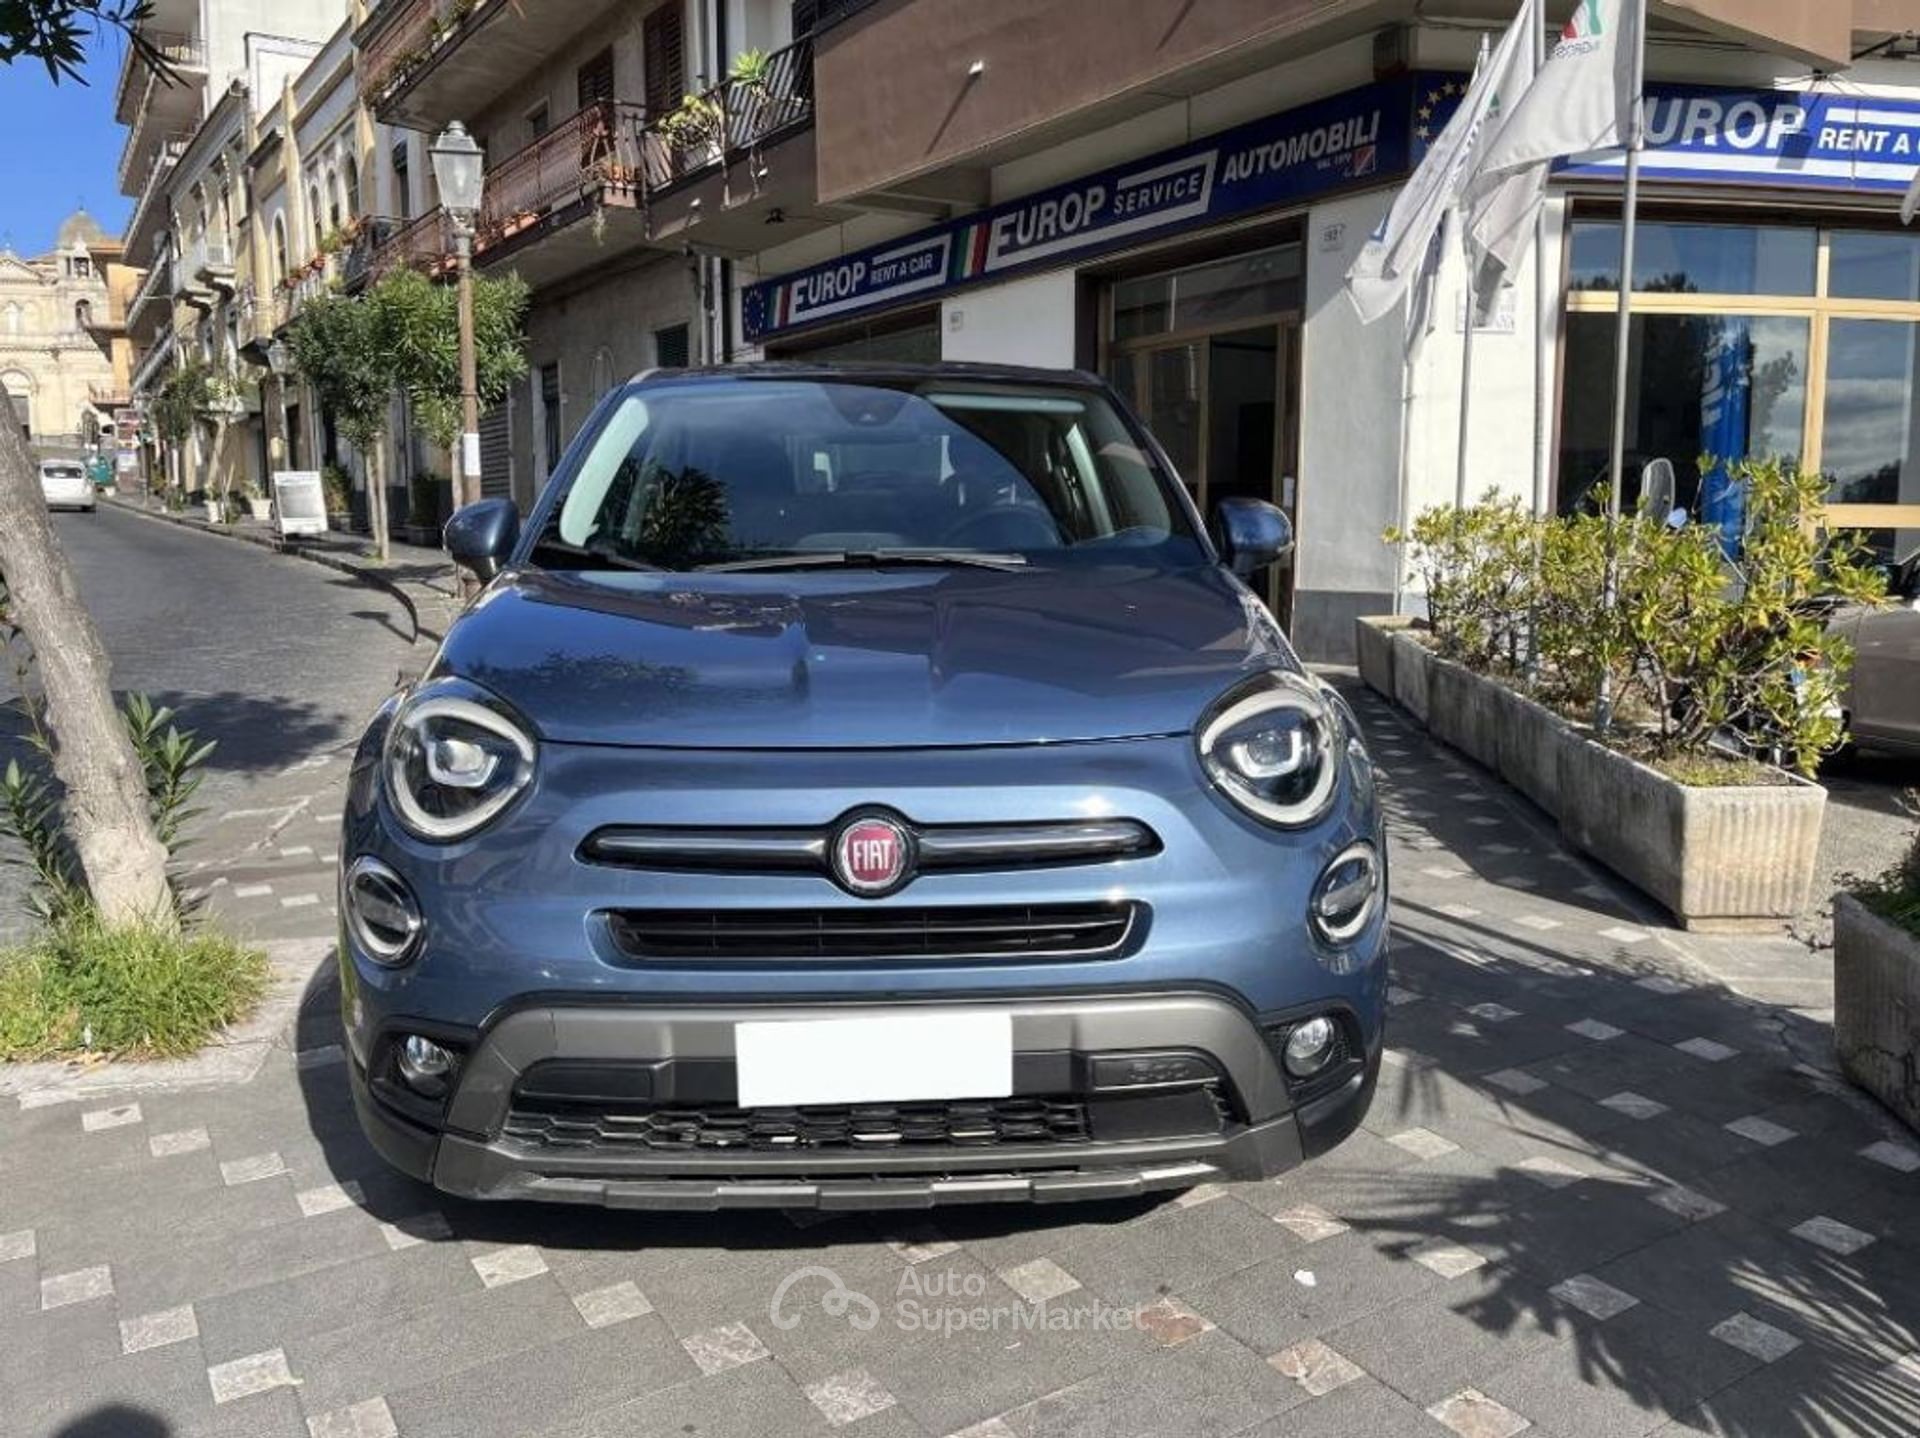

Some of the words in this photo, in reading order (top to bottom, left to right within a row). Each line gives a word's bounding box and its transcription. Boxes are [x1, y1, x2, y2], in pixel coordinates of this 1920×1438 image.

[1642, 96, 1806, 149] UROP
[1817, 127, 1891, 153] RENT
[1891, 133, 1910, 154] A
[985, 186, 1106, 272] EUROP
[1113, 173, 1200, 215] SERVICE
[1222, 110, 1380, 185] AUTOMOBILI
[788, 261, 866, 322] EUROP
[870, 264, 897, 285] RENT
[910, 253, 933, 273] CAR
[853, 840, 892, 871] FIAT
